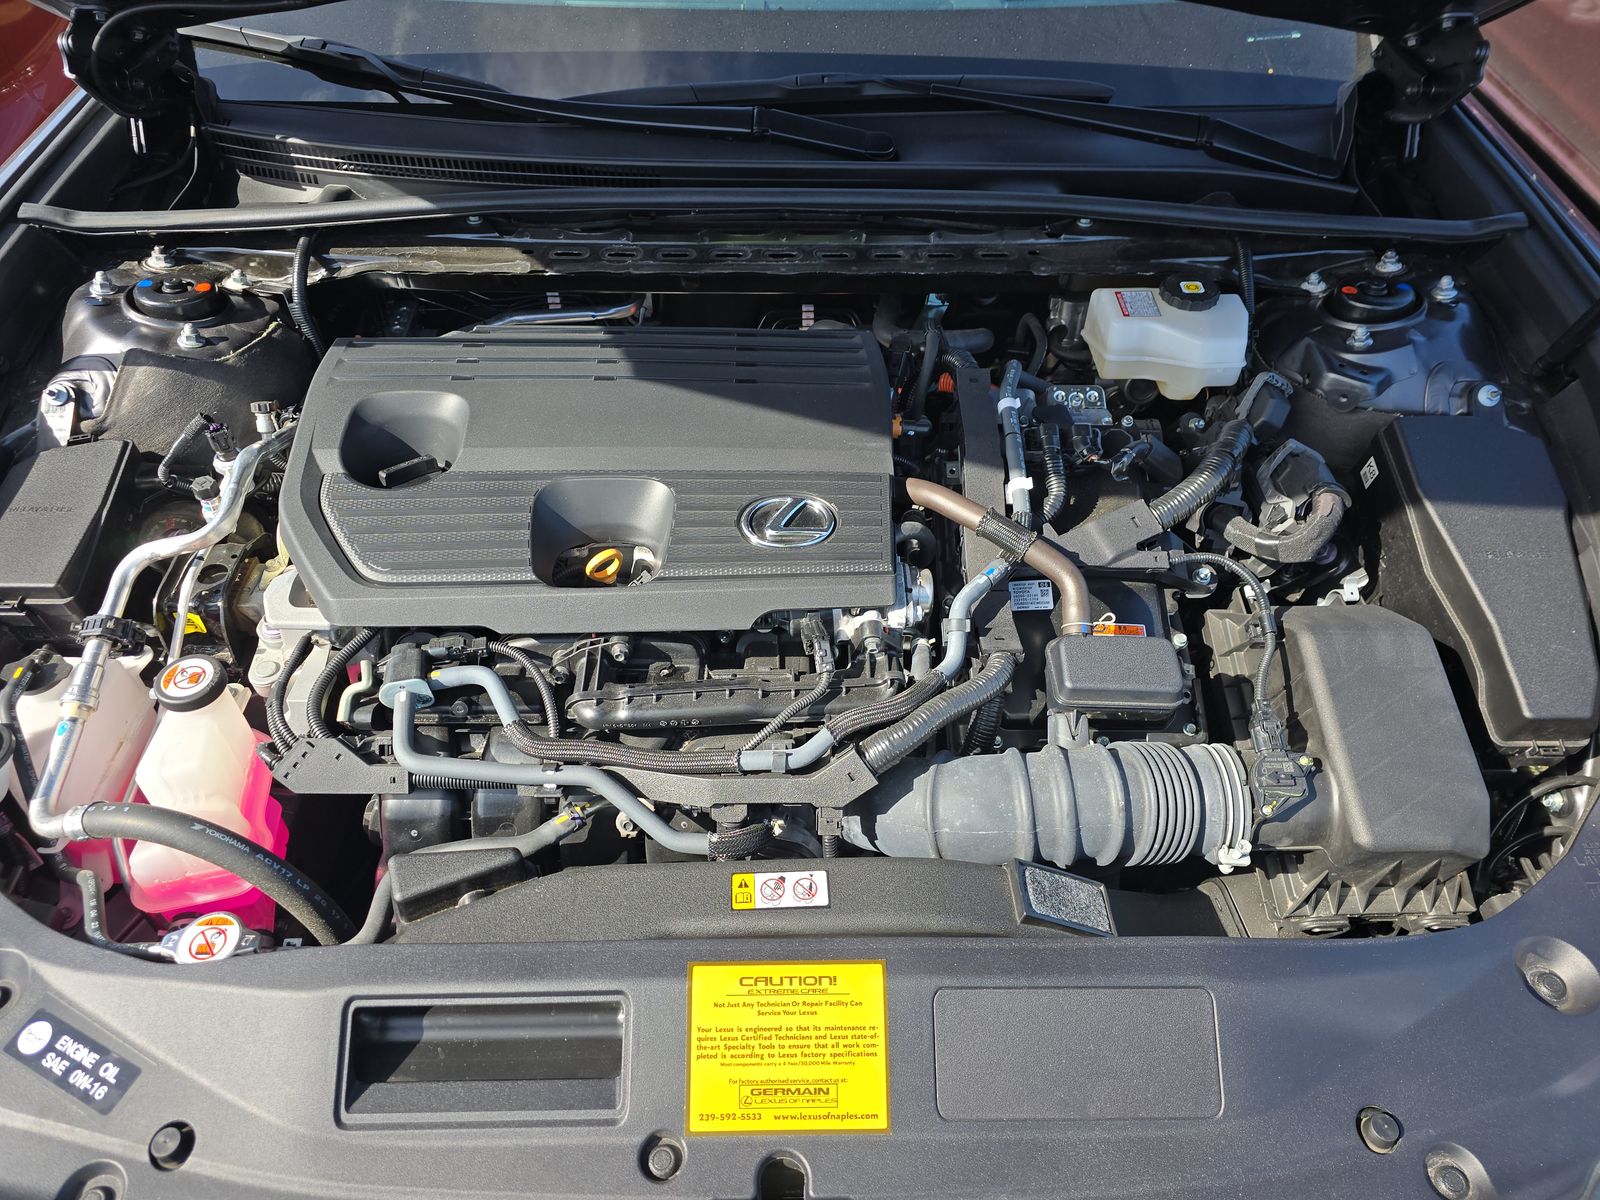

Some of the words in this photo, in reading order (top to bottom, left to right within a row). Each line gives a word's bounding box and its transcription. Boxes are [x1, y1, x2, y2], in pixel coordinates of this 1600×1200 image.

[204, 828, 250, 853] YOKOHAMA
[739, 976, 837, 987] CAUTION!
[742, 1001, 755, 1009] Any
[757, 1000, 791, 1008] Technician
[802, 1000, 823, 1008] Repair
[825, 1000, 848, 1009] Facility
[757, 1009, 782, 1017] Service
[745, 1025, 782, 1034] engineered
[696, 1035, 717, 1043] quires
[850, 1032, 879, 1040] state-of-
[723, 1043, 755, 1052] Specialty
[55, 1035, 100, 1069] ENGINE
[98, 1062, 120, 1084] OIL
[696, 1053, 718, 1061] pleted
[730, 1052, 765, 1060] according
[800, 1051, 826, 1059] factory
[829, 1050, 878, 1059] specifications
[41, 1052, 70, 1076] SAE
[68, 1069, 108, 1100] 0W-16
[750, 1087, 830, 1096] GERMAIN
[698, 1112, 762, 1121] 239-592-5533
[773, 1111, 879, 1122] www.lexusofnaples.com
